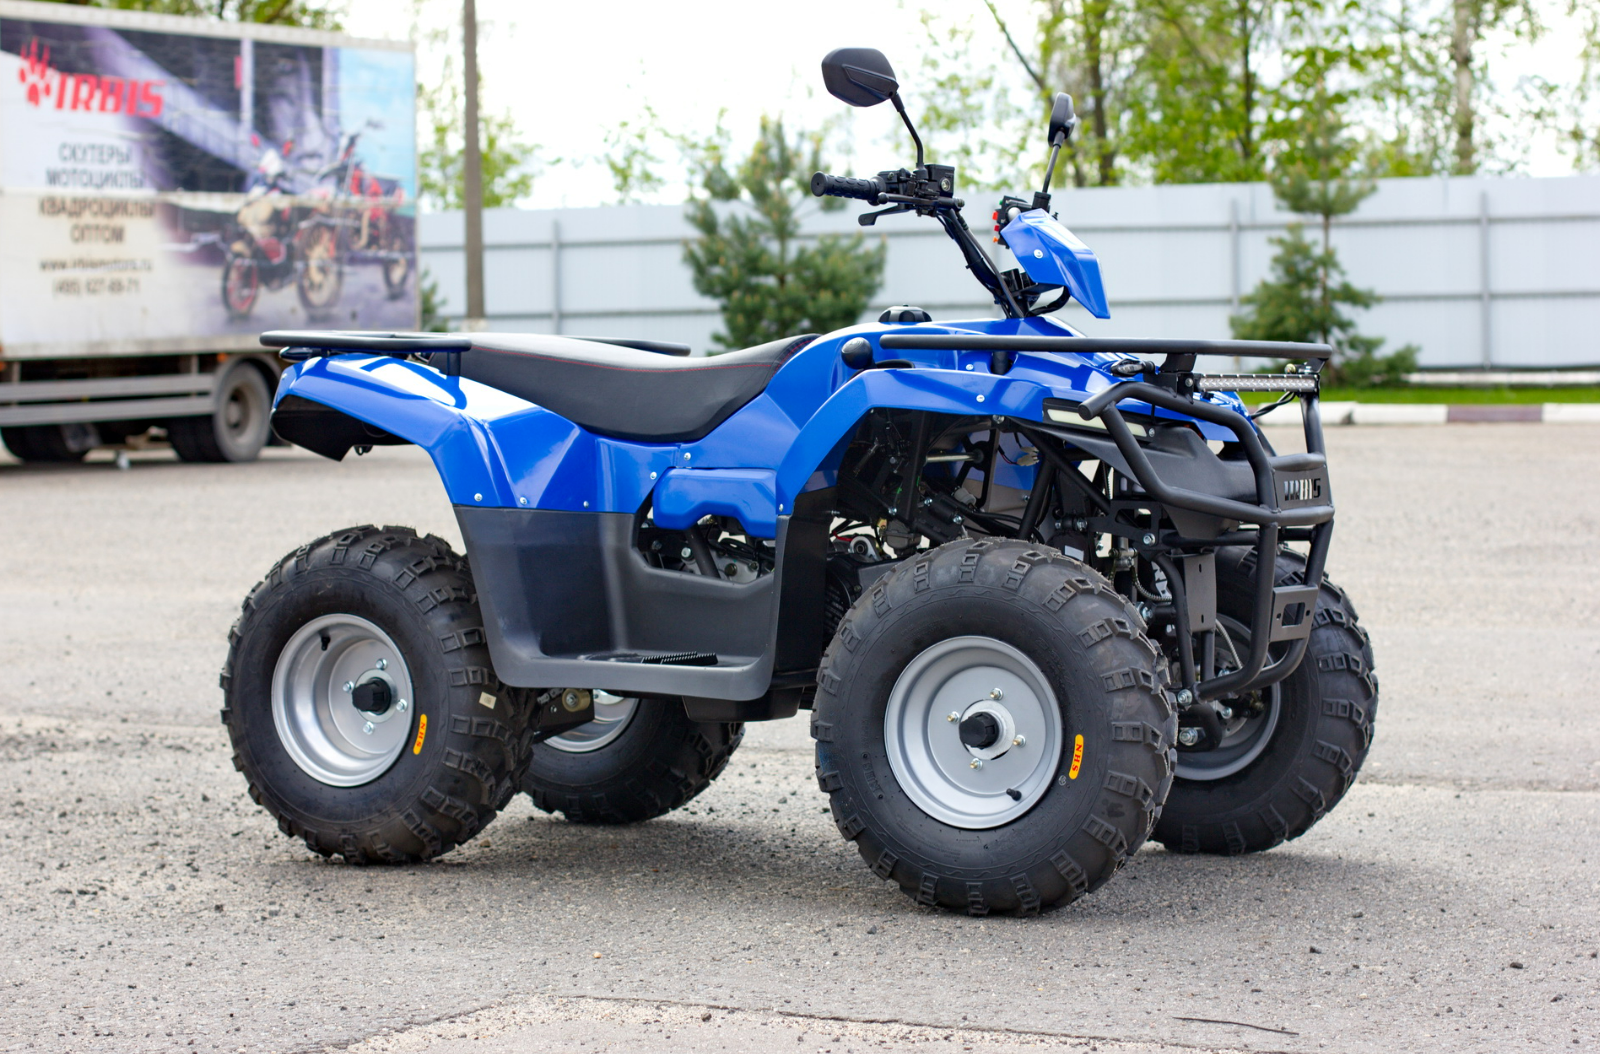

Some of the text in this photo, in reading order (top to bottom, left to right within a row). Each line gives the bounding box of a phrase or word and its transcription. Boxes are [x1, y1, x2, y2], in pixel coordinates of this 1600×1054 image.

[55, 72, 166, 118] IRBIS
[58, 142, 131, 164] СКУТЕРЫ
[70, 224, 126, 244] ОПТОМ
[1284, 478, 1321, 501] IRBIS
[1071, 743, 1083, 772] NHS
